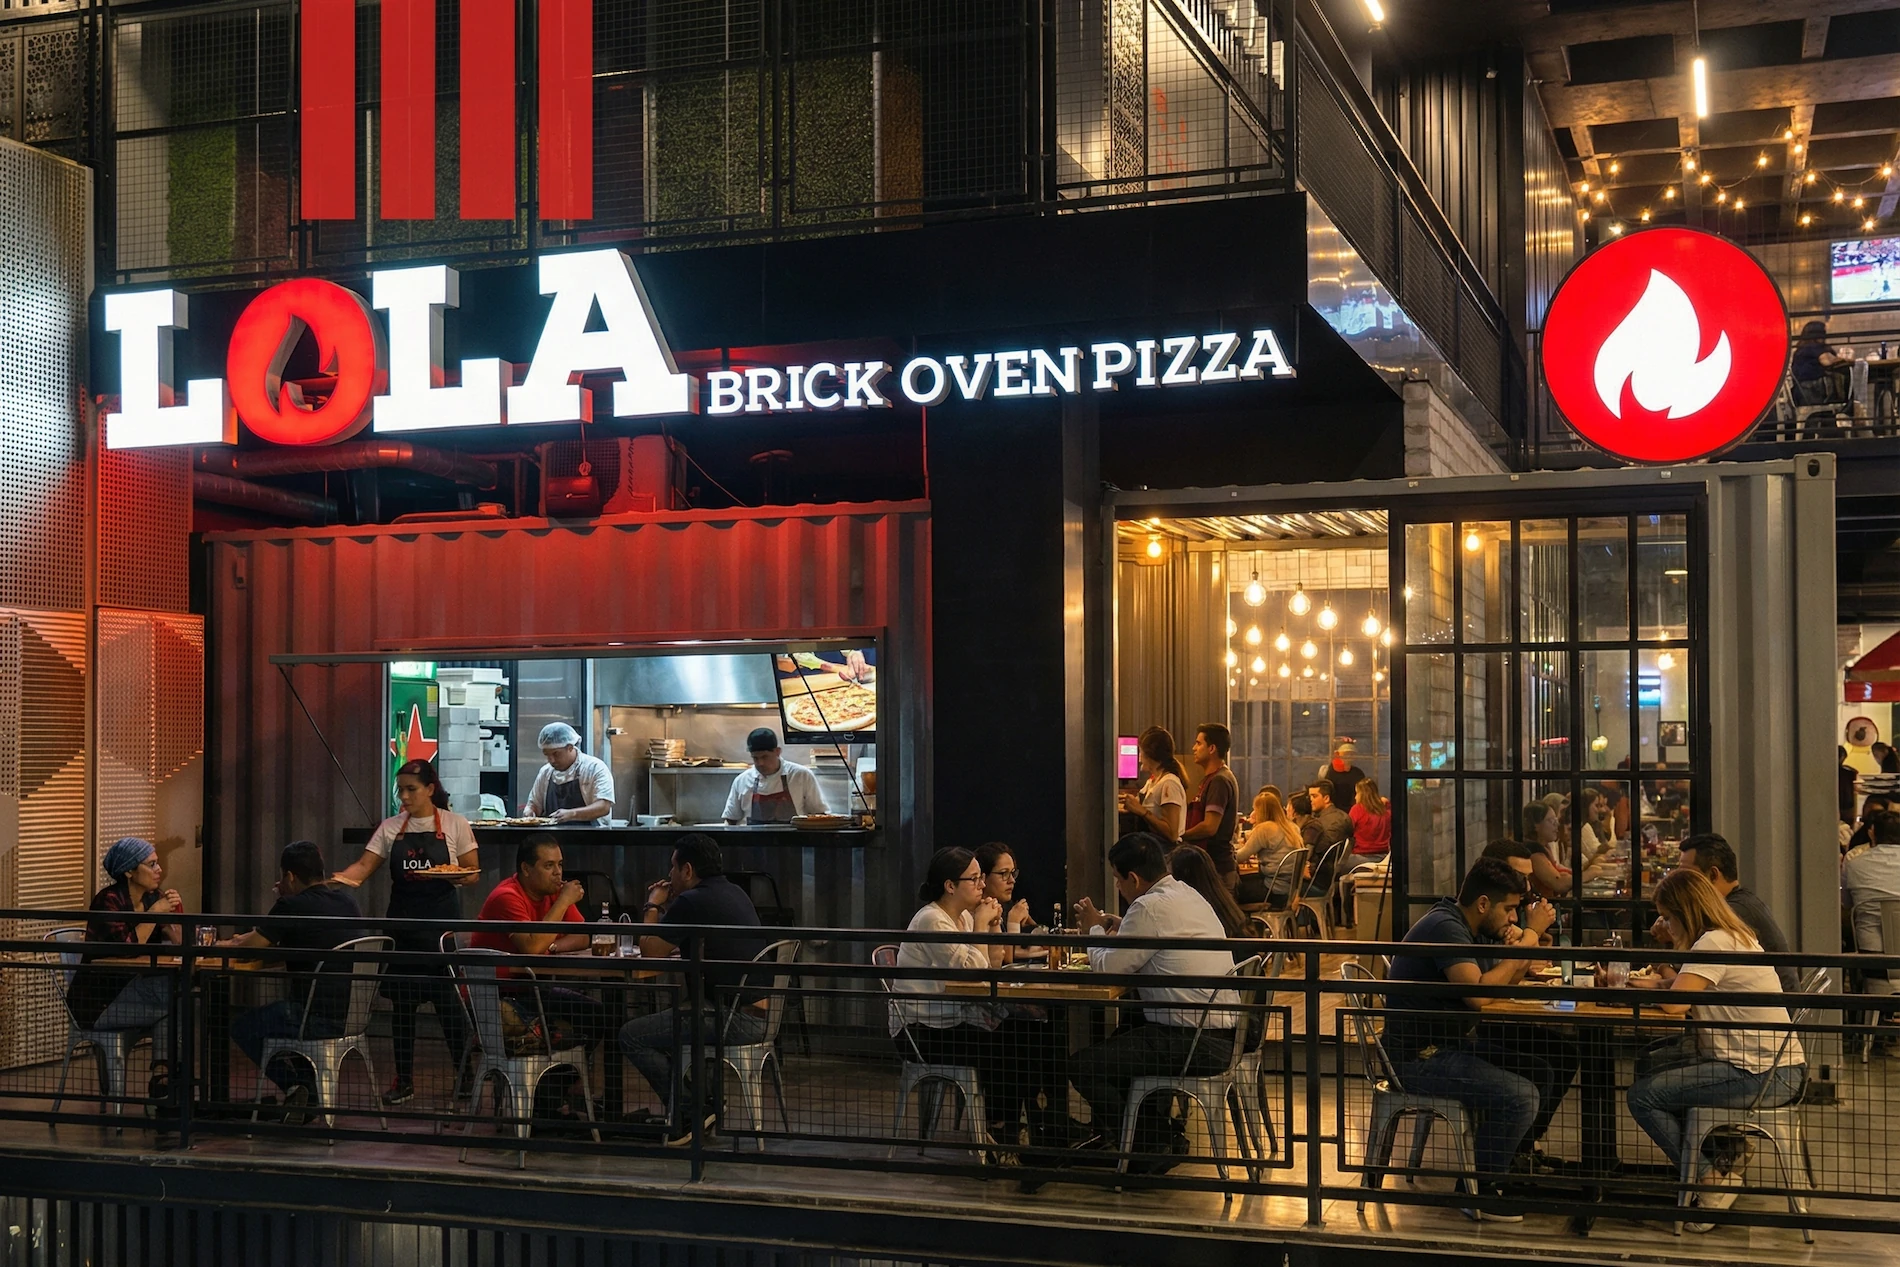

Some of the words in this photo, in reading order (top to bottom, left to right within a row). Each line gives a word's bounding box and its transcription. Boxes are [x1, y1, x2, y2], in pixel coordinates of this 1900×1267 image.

[104, 248, 692, 451] LOLA
[707, 362, 886, 415] BRICK
[901, 346, 1080, 407] OVEN
[1092, 329, 1292, 390] PIZZA
[403, 859, 431, 870] LOLA
